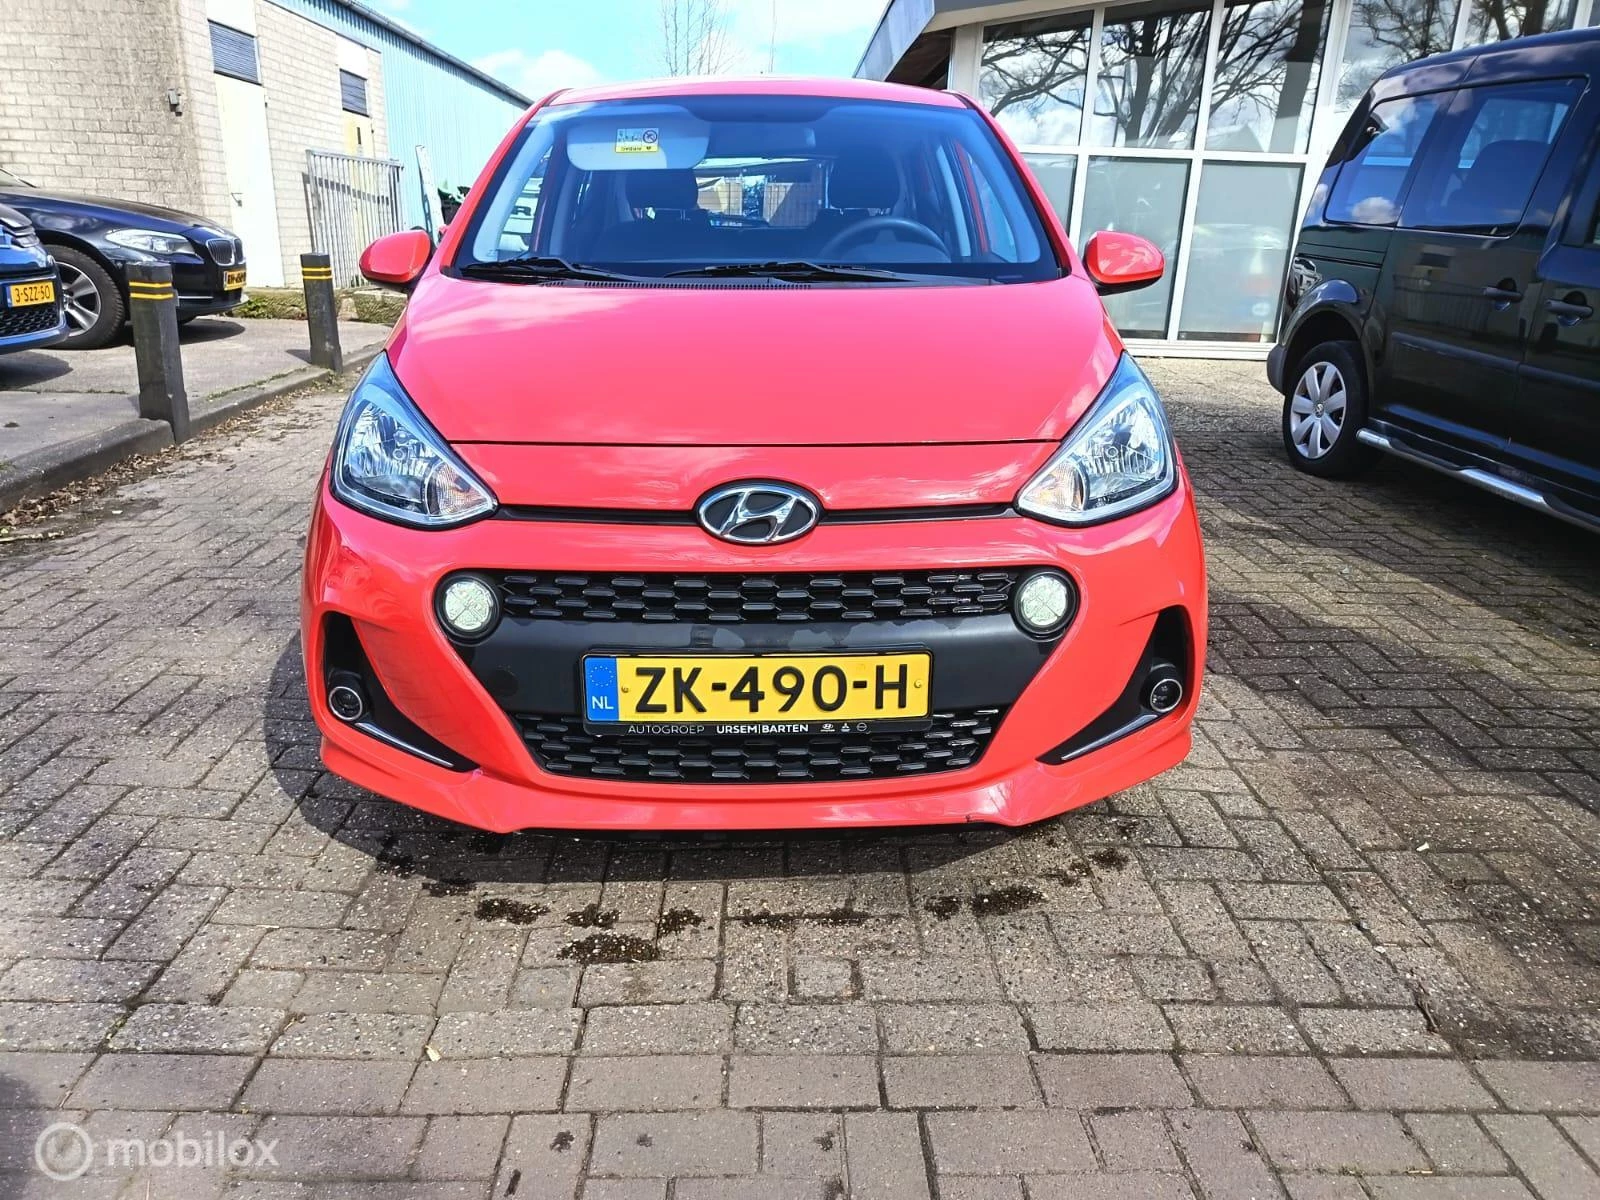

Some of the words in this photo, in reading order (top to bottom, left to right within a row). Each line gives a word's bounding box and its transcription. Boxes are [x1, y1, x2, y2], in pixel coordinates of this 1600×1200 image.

[635, 664, 908, 713] ZK-490-H
[592, 696, 614, 710] NL
[628, 725, 705, 734] AUTOGROEP
